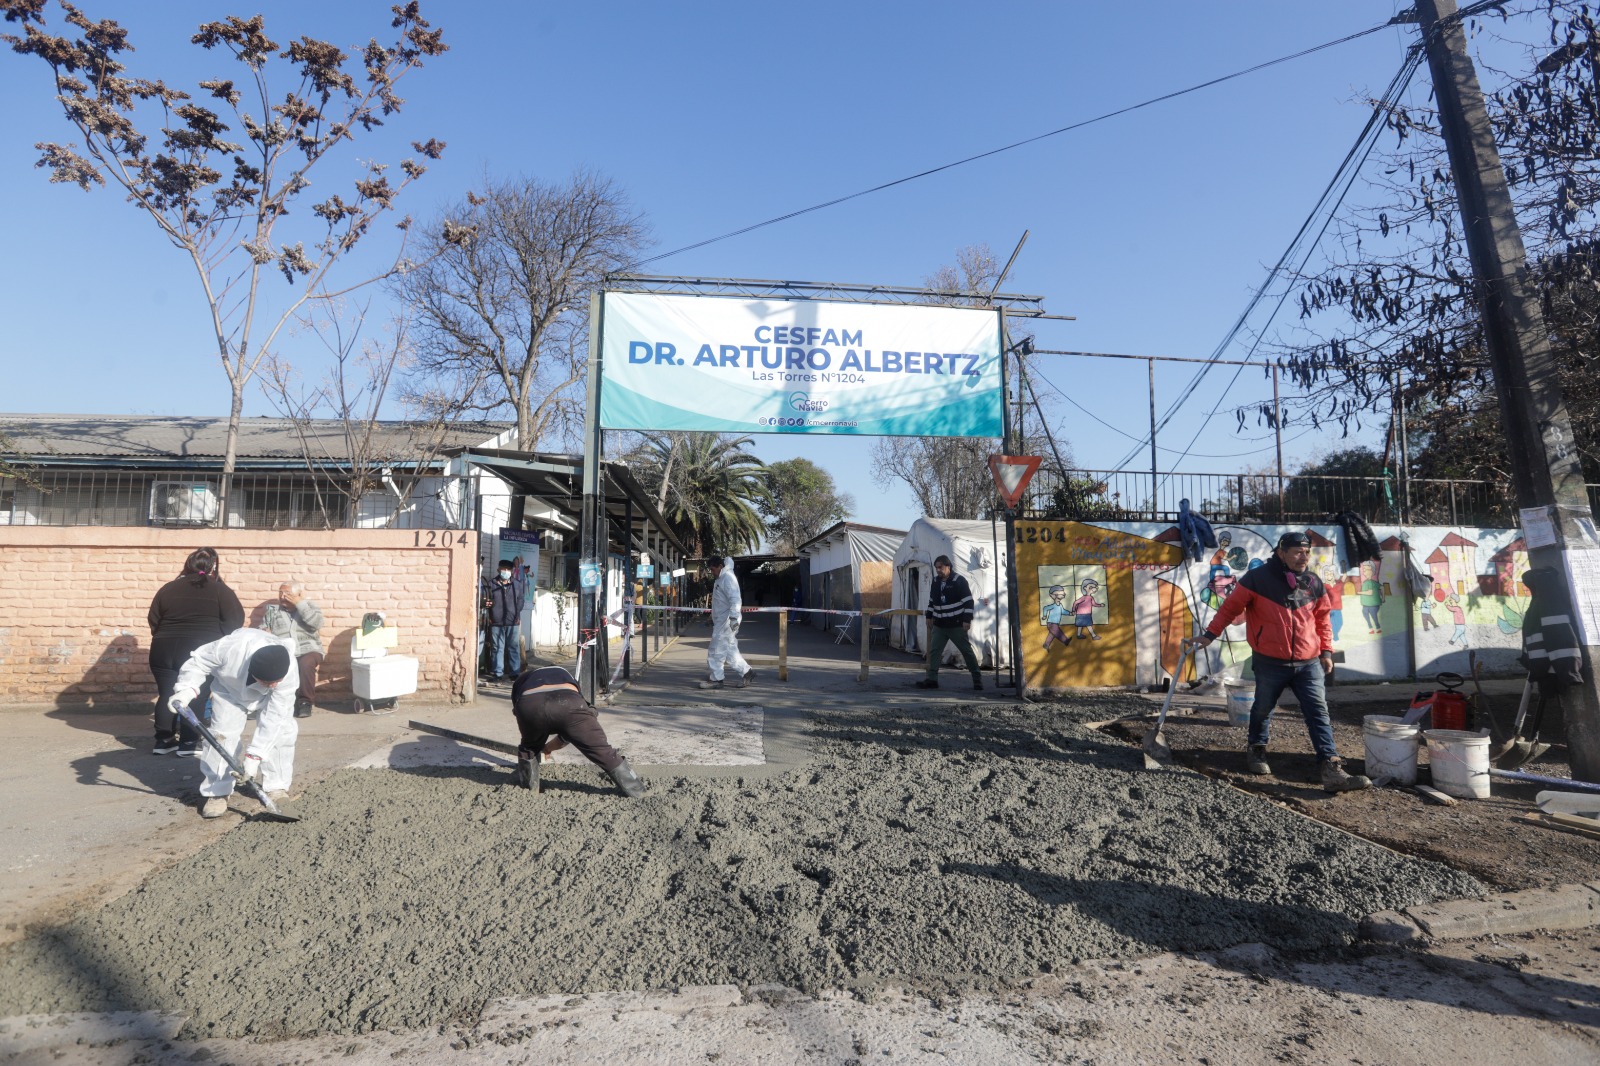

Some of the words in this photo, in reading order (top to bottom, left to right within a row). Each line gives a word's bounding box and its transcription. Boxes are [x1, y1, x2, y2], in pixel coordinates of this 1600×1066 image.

[754, 325, 863, 347] CESFAM
[628, 341, 685, 366] DR.
[693, 344, 832, 370] ARTURO
[839, 349, 980, 375] ALBERTZ
[752, 370, 774, 381] Las
[777, 371, 817, 382] Torres
[798, 404, 823, 412] Navia
[804, 399, 828, 407] Cerro
[806, 419, 858, 427] /cmcerronavia
[414, 530, 468, 549] 1204
[1015, 527, 1066, 543] 1204
